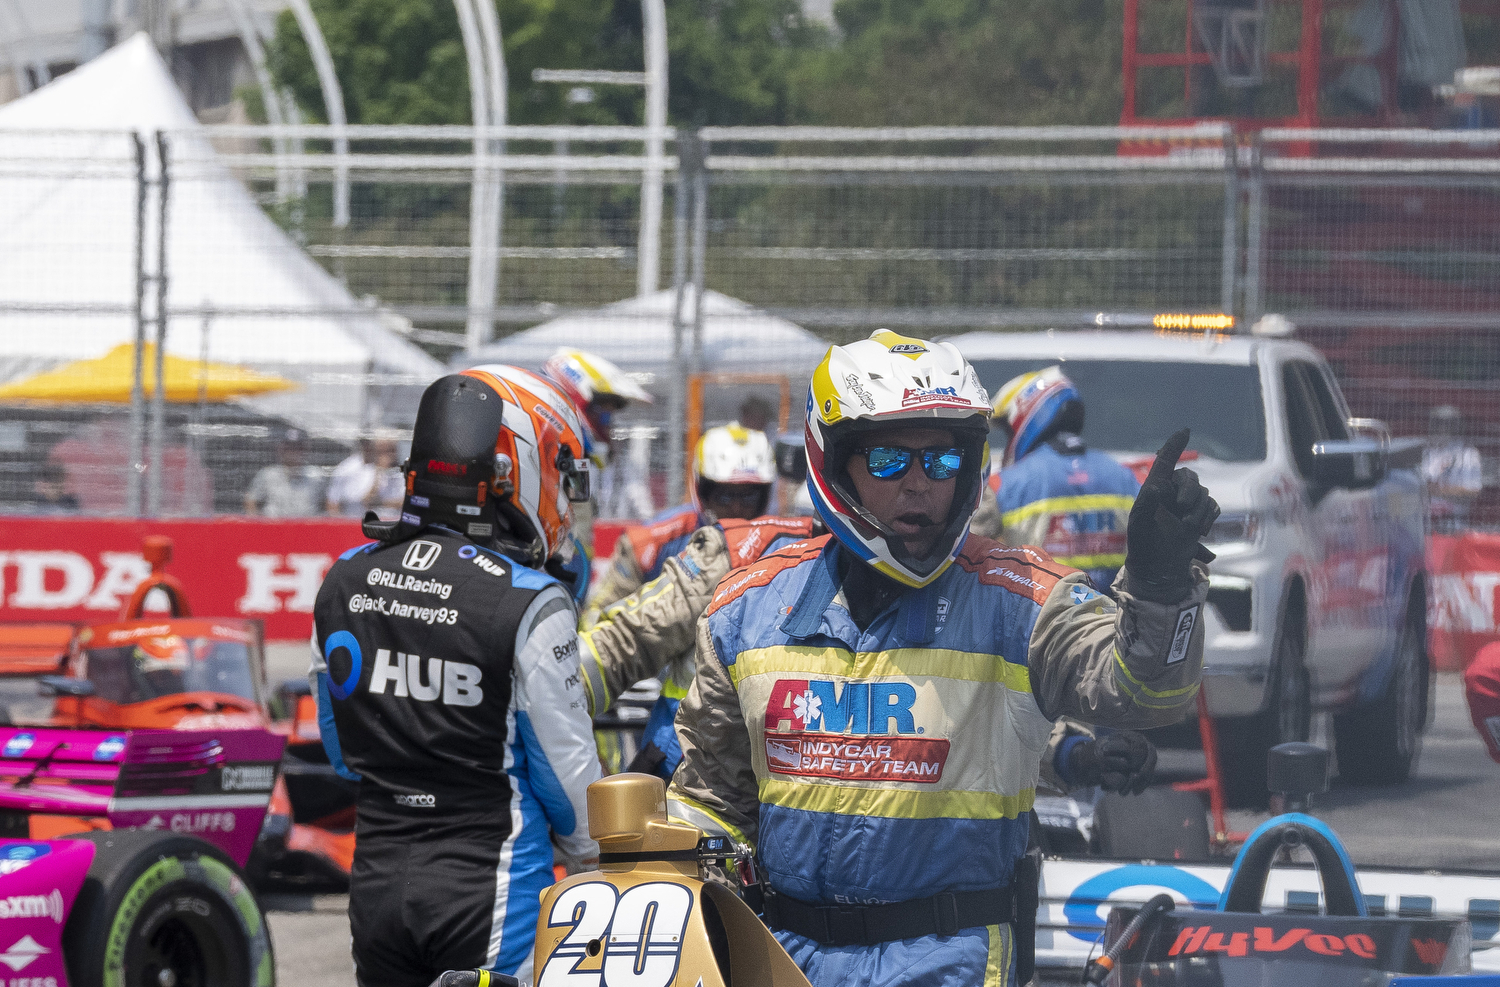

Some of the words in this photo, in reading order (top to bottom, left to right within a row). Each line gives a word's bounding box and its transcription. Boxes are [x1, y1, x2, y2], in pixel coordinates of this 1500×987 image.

[367, 568, 453, 600] @RLLRacing
[349, 594, 459, 625] @jack_harvey93
[369, 648, 485, 708] HUB
[765, 679, 916, 734] AMR
[802, 742, 892, 758] INDYCAR
[801, 757, 876, 772] SAFETY
[880, 760, 939, 775] TEAM
[170, 813, 236, 832] CLIFFS
